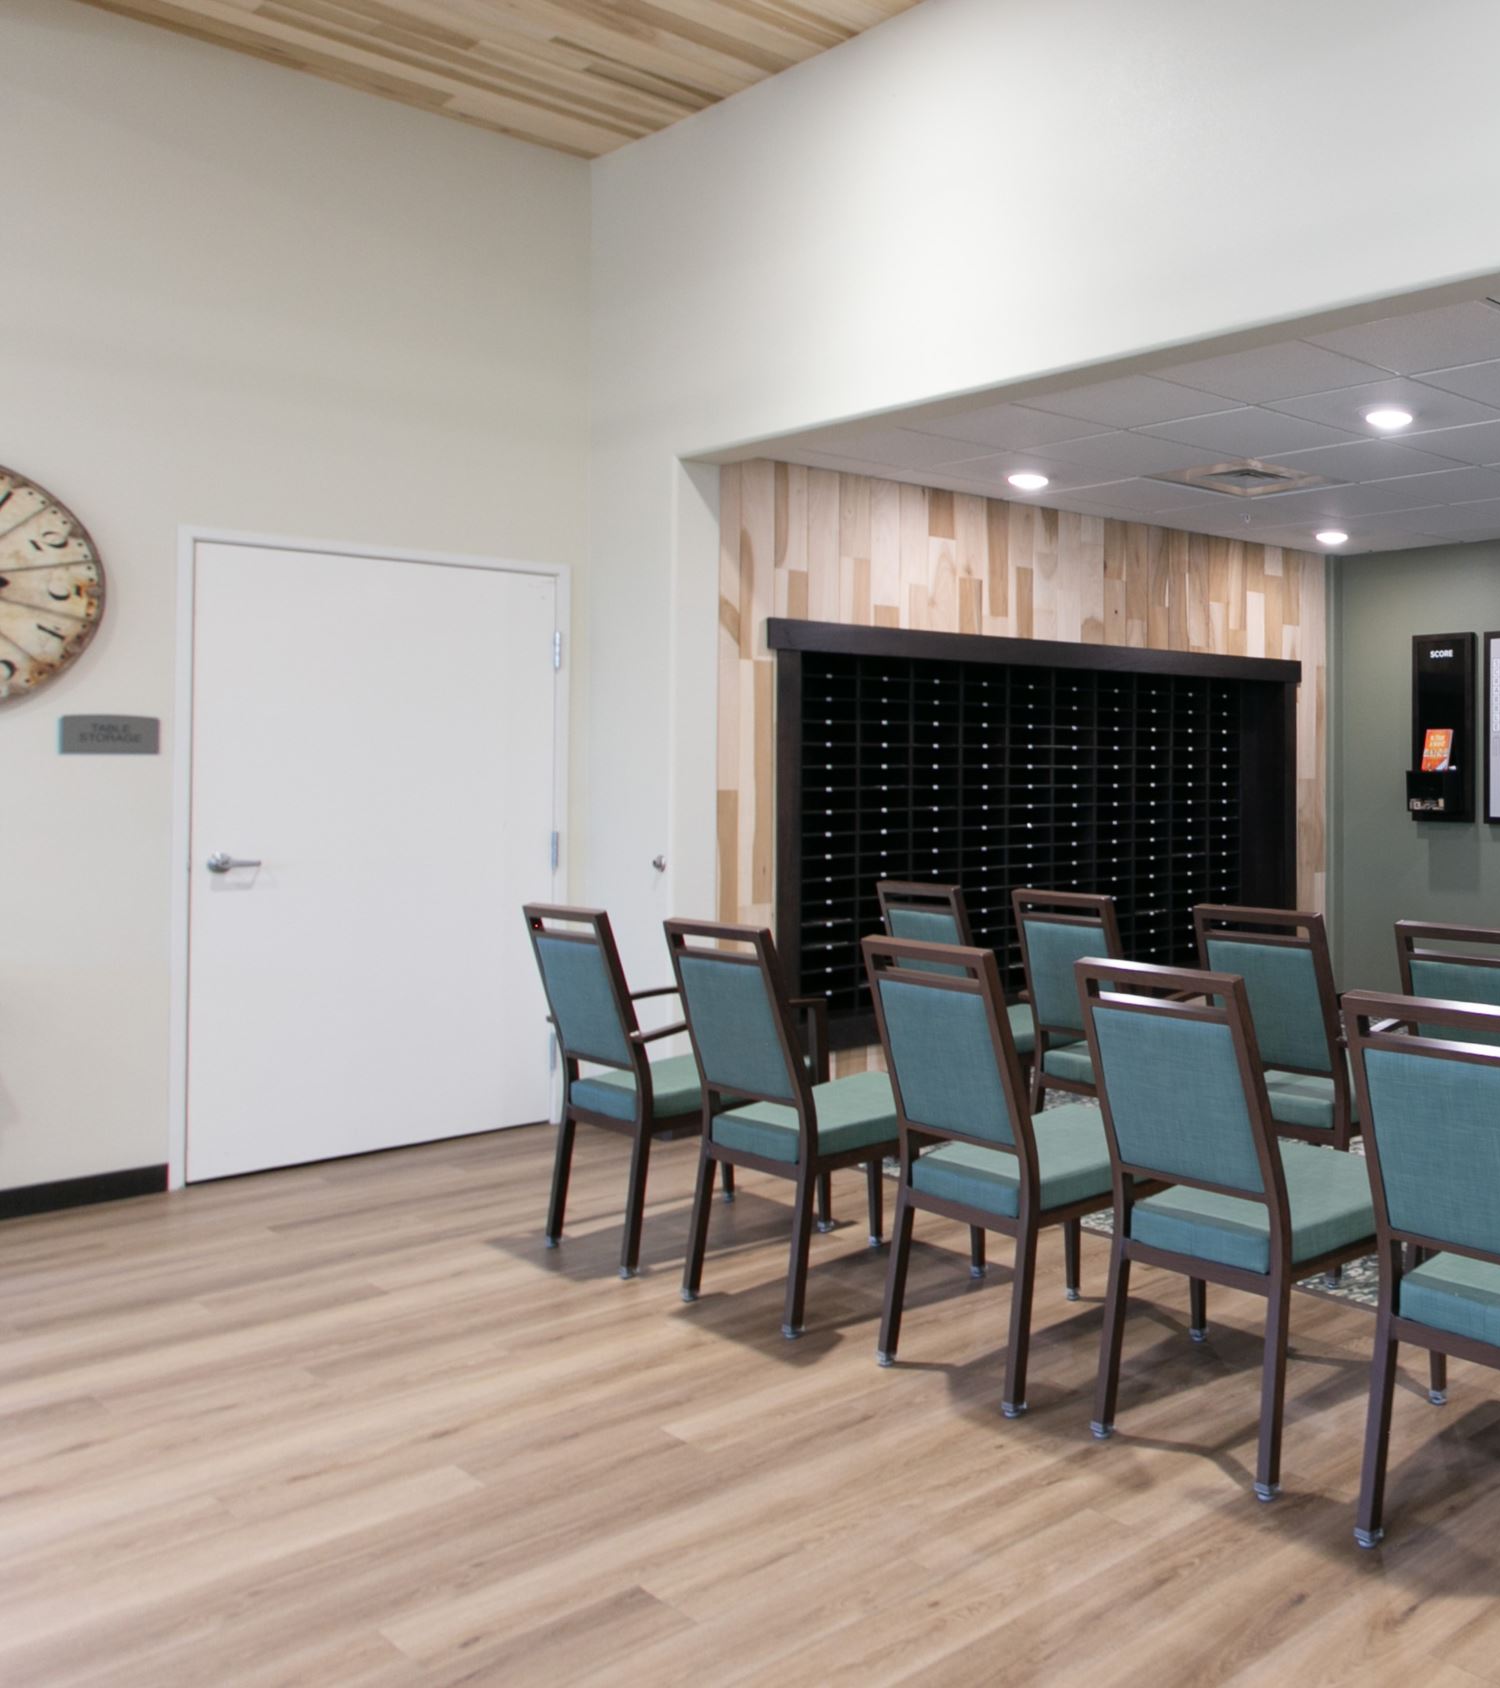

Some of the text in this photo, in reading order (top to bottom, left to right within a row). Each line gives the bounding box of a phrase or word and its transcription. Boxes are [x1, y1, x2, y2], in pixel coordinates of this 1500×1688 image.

[1430, 649, 1454, 659] SCORE
[91, 723, 130, 733] TABLE
[79, 733, 142, 744] STORAGE
